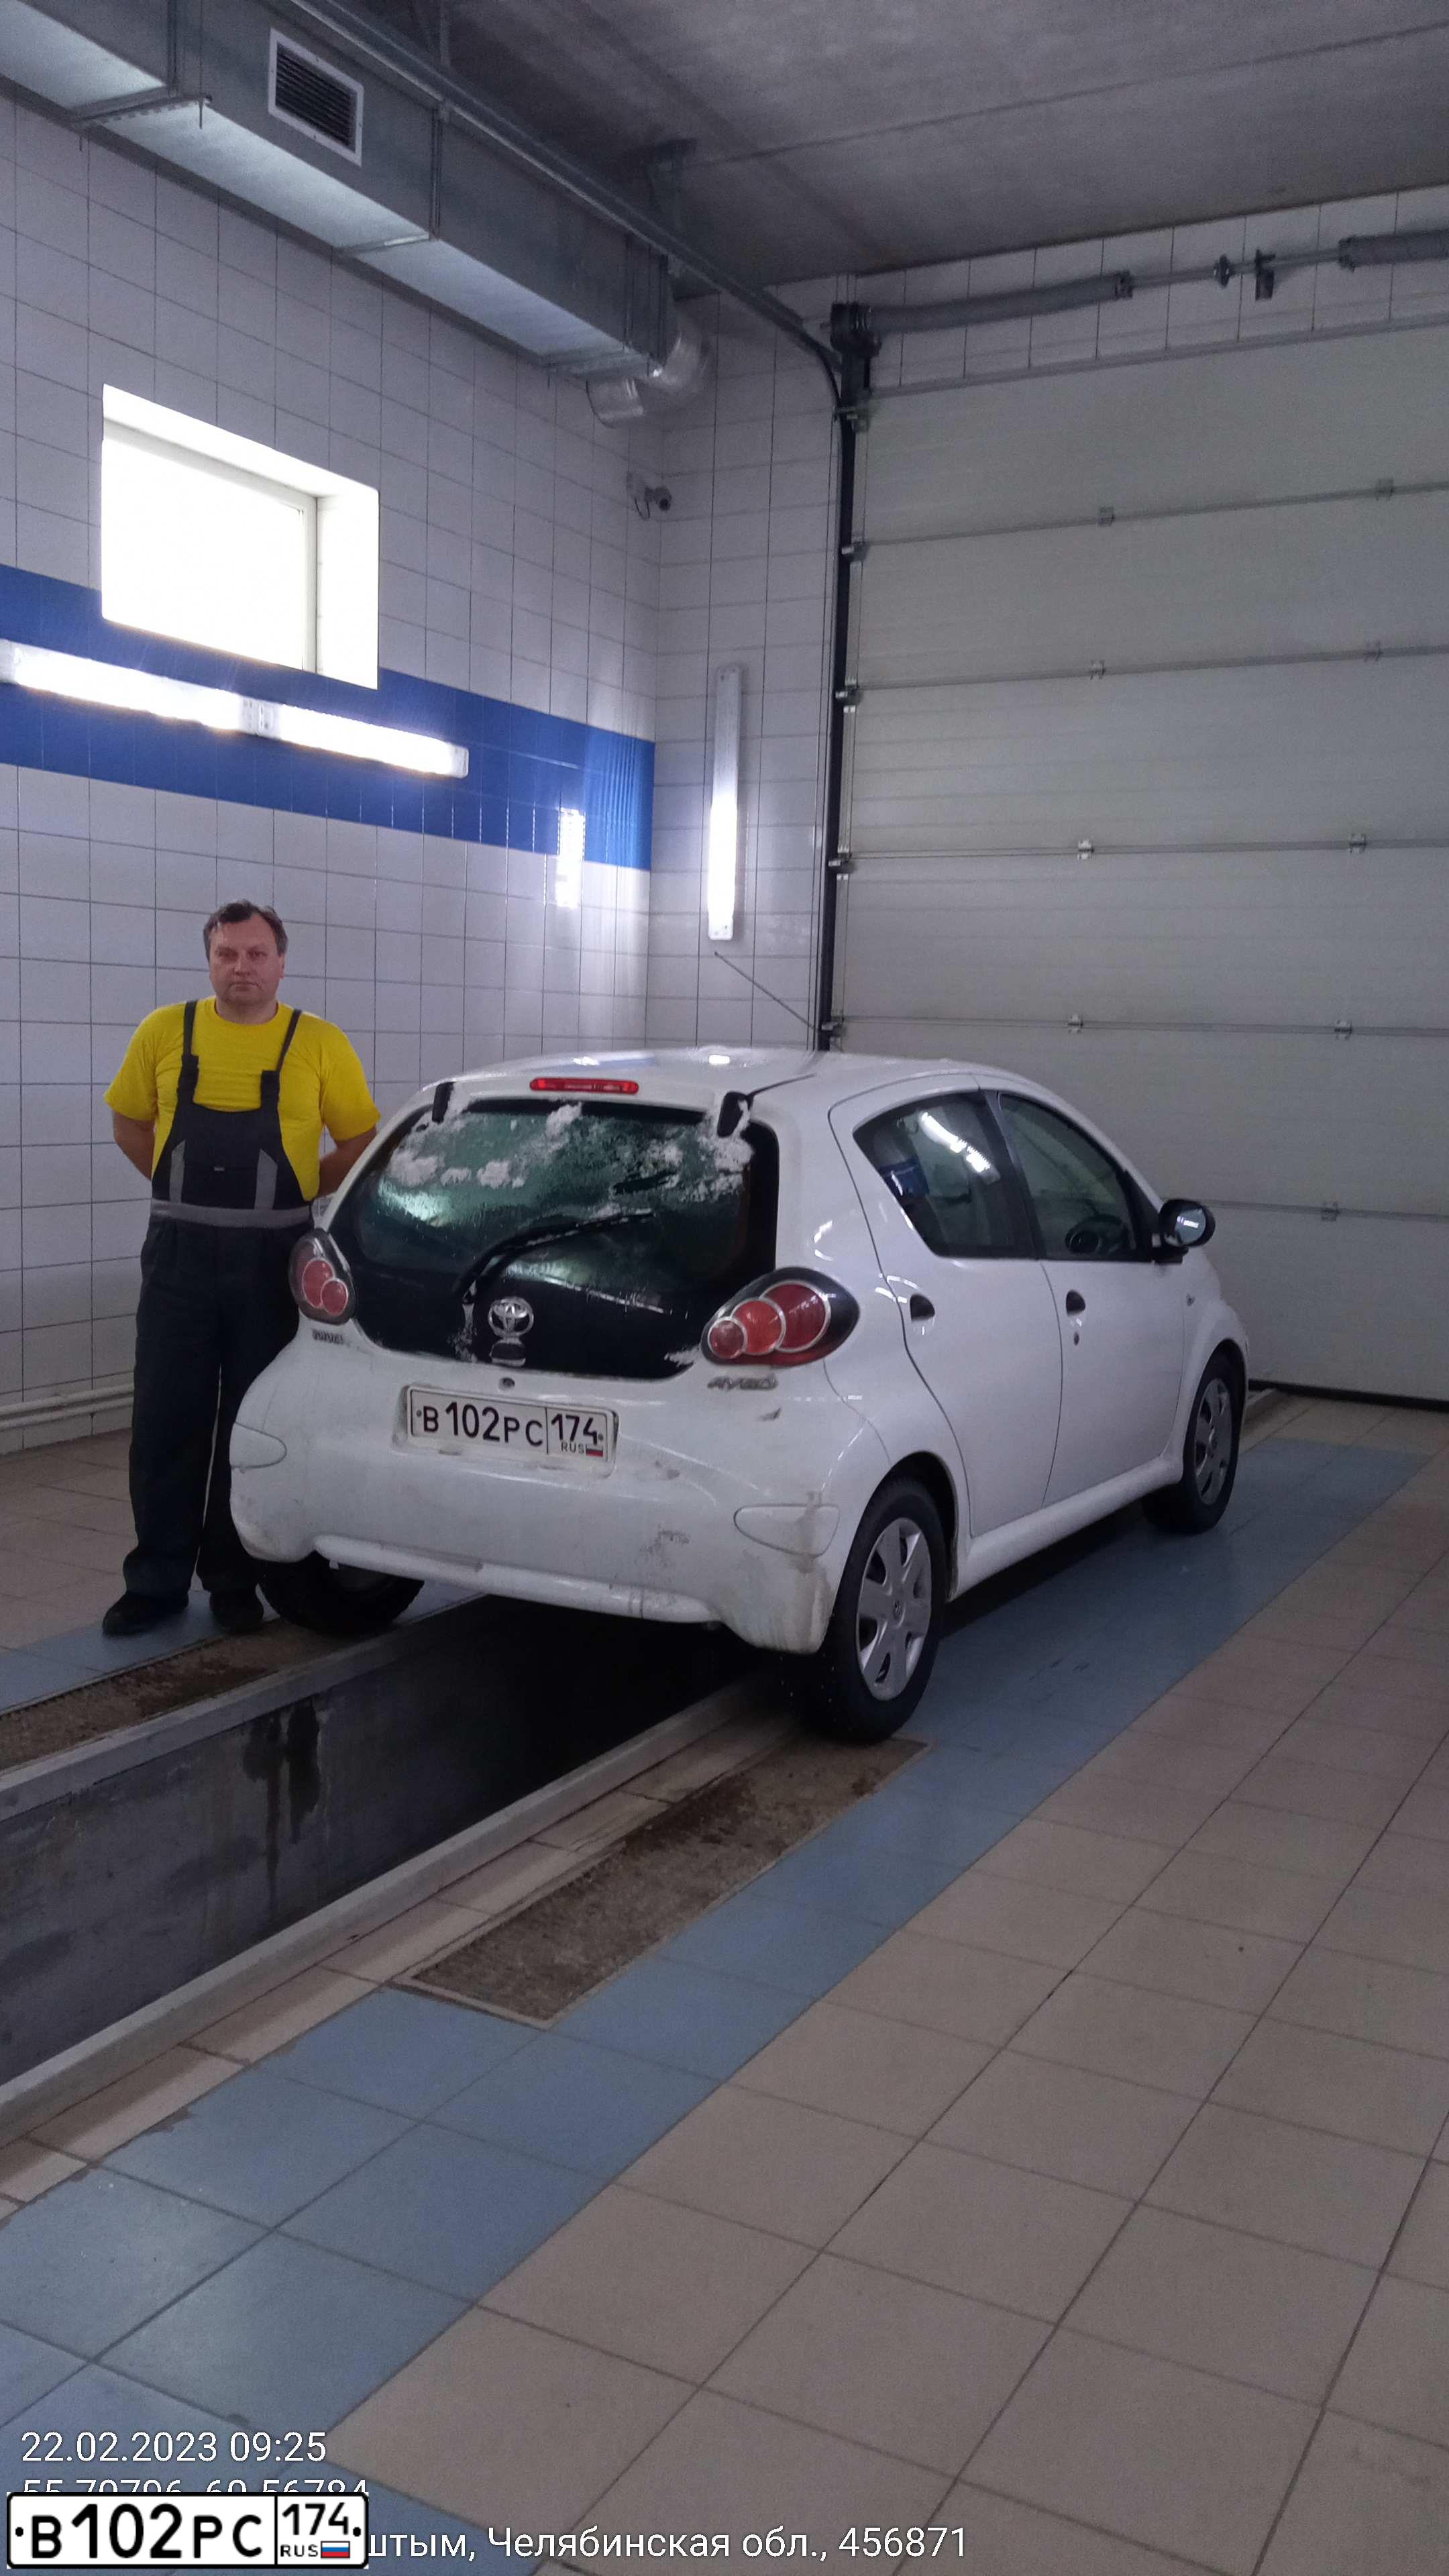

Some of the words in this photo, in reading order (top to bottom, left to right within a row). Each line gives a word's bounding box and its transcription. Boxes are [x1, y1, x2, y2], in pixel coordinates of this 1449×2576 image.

[423, 1401, 543, 1447] В102РС
[551, 1413, 599, 1446] 174
[561, 1441, 586, 1454] RUS
